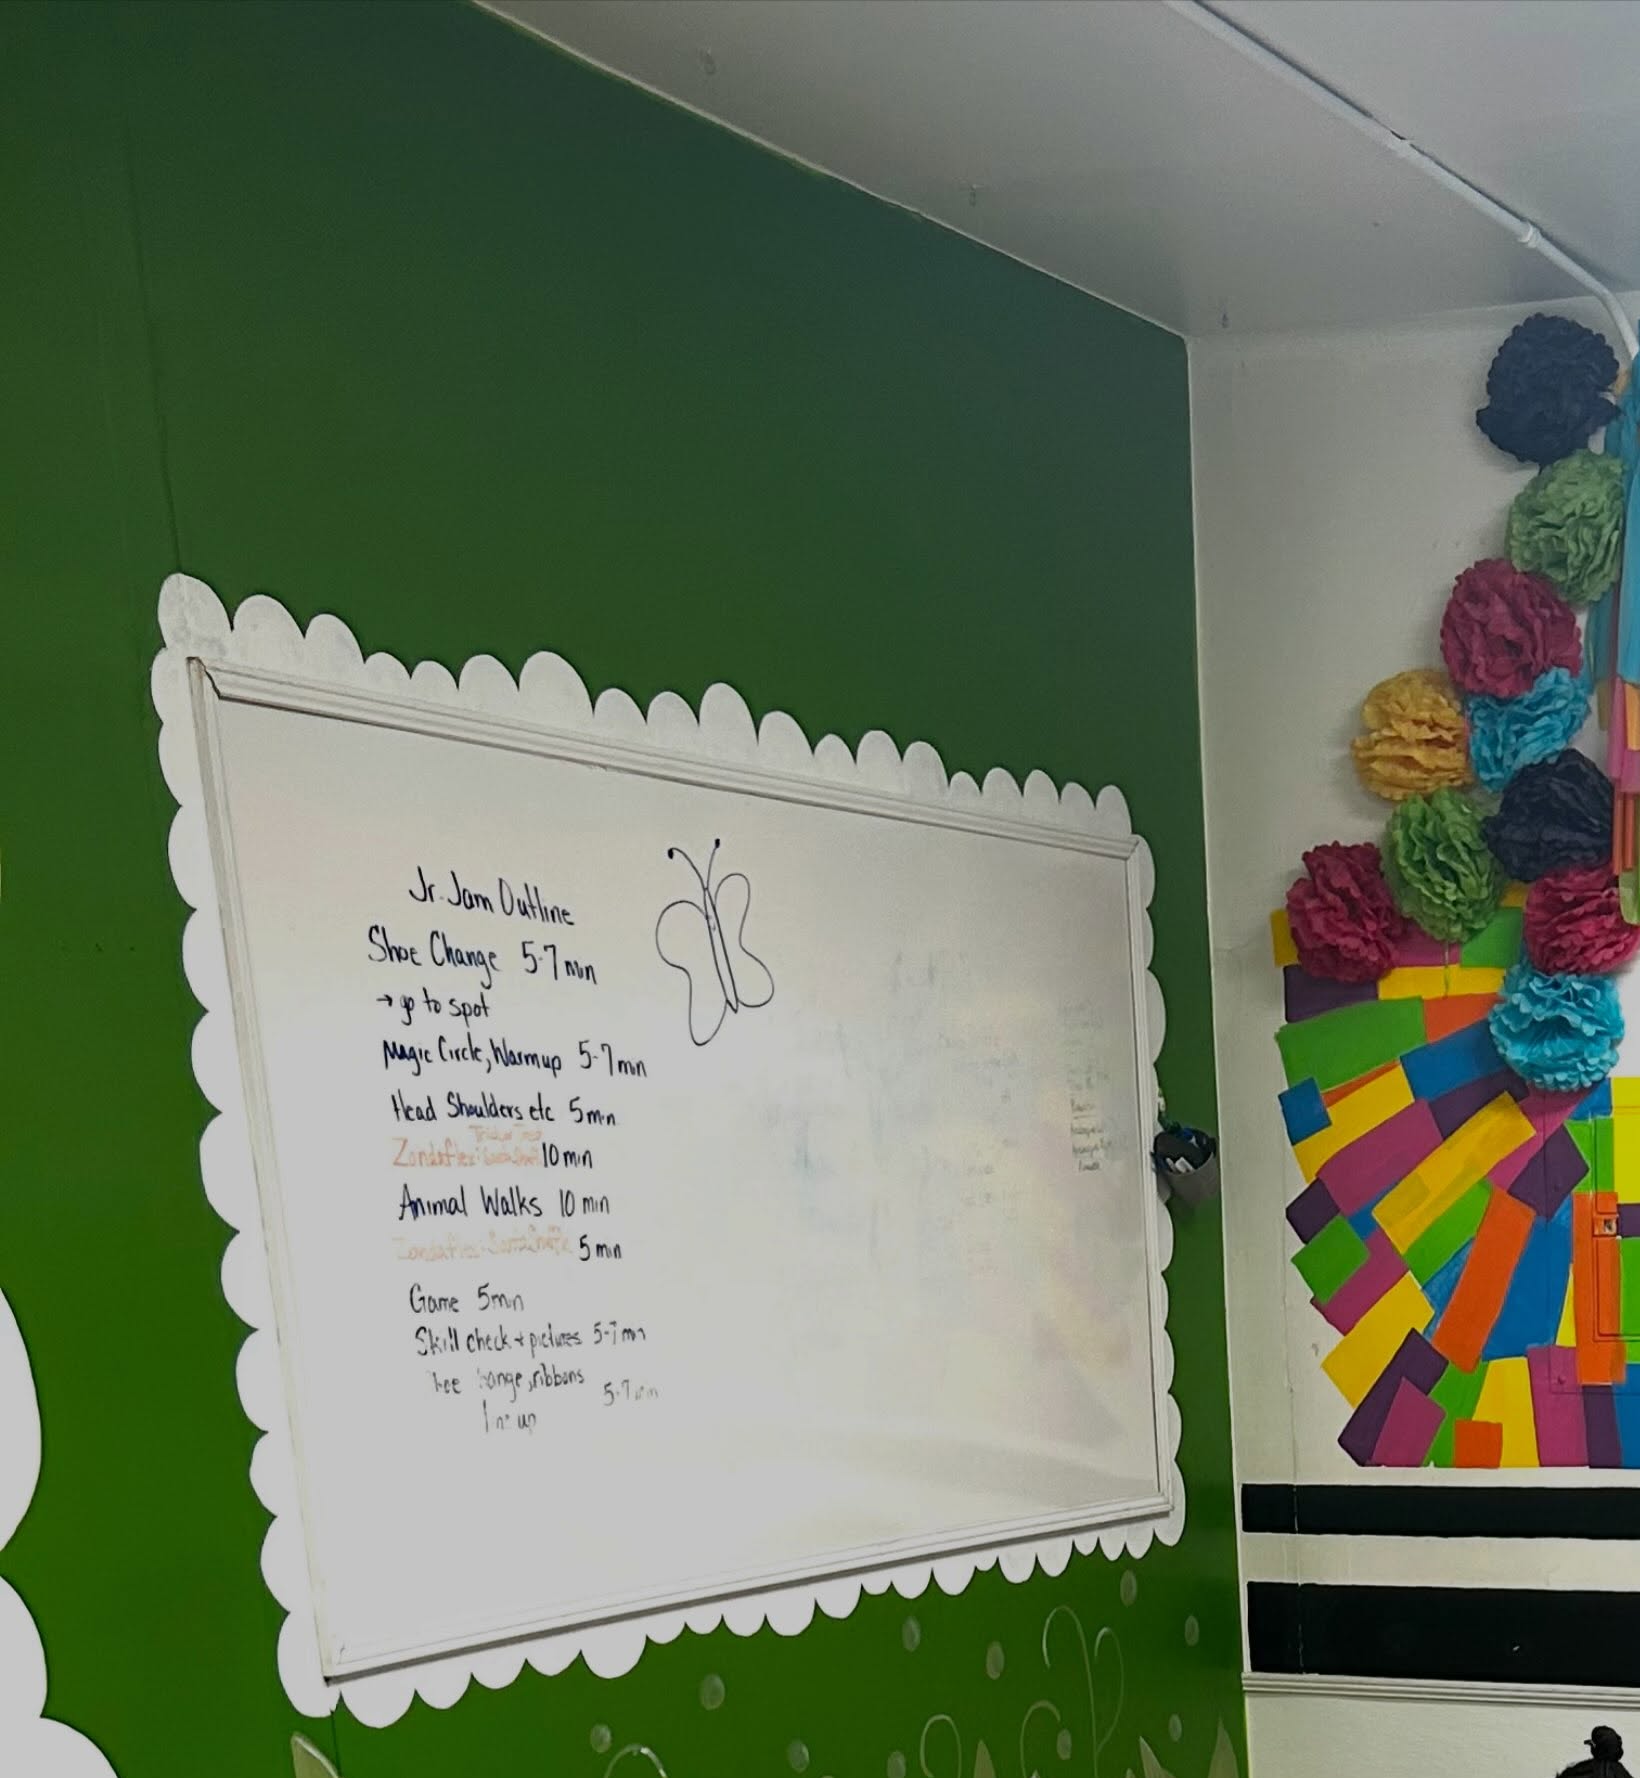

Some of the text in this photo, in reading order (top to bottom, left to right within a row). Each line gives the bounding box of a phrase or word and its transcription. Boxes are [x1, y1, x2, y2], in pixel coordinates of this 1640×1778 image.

[408, 864, 576, 927] Jr. Jam Outline
[367, 923, 423, 967] Shoe
[429, 929, 501, 991] Change
[563, 959, 598, 986] min
[399, 986, 491, 1029] go to spot
[382, 1039, 434, 1078] Magic
[578, 1039, 614, 1077] 5-7
[617, 1059, 648, 1078] min
[390, 1088, 438, 1123] Head
[446, 1090, 524, 1121] Shoulders
[528, 1091, 556, 1122] etc
[541, 1141, 560, 1169] 10
[562, 1149, 593, 1170] min
[397, 1182, 611, 1222] Animal Walks 10 min
[578, 1233, 592, 1262] 5
[595, 1242, 623, 1260] min
[408, 1282, 460, 1314] Game
[414, 1325, 460, 1357] Skill
[465, 1323, 513, 1354] check
[432, 1371, 462, 1394] hoe
